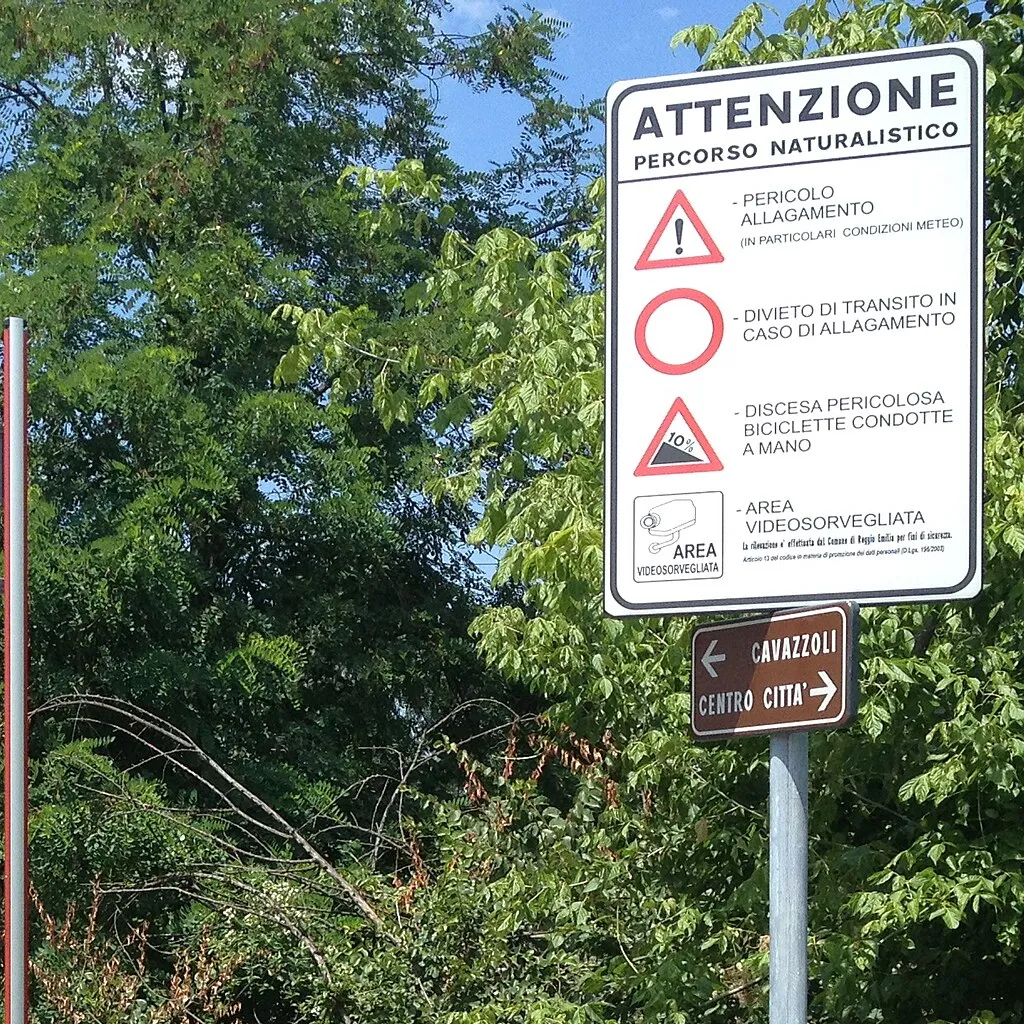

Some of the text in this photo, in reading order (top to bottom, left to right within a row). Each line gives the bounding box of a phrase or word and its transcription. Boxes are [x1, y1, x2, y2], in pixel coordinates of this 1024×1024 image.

[632, 71, 957, 141] ATTENZIONE
[634, 121, 959, 171] PERCORSO NATURALISTICO
[743, 185, 835, 208] PERICOLO
[740, 200, 875, 227] ALLAGAMENTO
[740, 217, 964, 249] (IN PARTICOLARI CONDIZIONI METEO)
[744, 303, 814, 323] DIVIETO
[820, 301, 837, 317] DI
[841, 293, 934, 315] TRANSITO
[939, 291, 957, 307] IN
[743, 311, 956, 342] CASO DI ALLAGAMENTO
[745, 399, 823, 418] DISCESA
[827, 390, 945, 412] PERICOLOSA
[744, 408, 954, 437] BICICLETTE CONDOTTE
[668, 432, 695, 452] 10%
[742, 438, 812, 456] A MANO
[745, 499, 795, 516] AREA
[745, 510, 926, 534] VIDEOSORVEGLIATA
[672, 542, 717, 560] AREA
[636, 561, 719, 577] VIDEOSORVEGLIATA
[751, 628, 838, 665] CAVAZZOLI
[698, 681, 809, 717] CENTRO CITTA'
